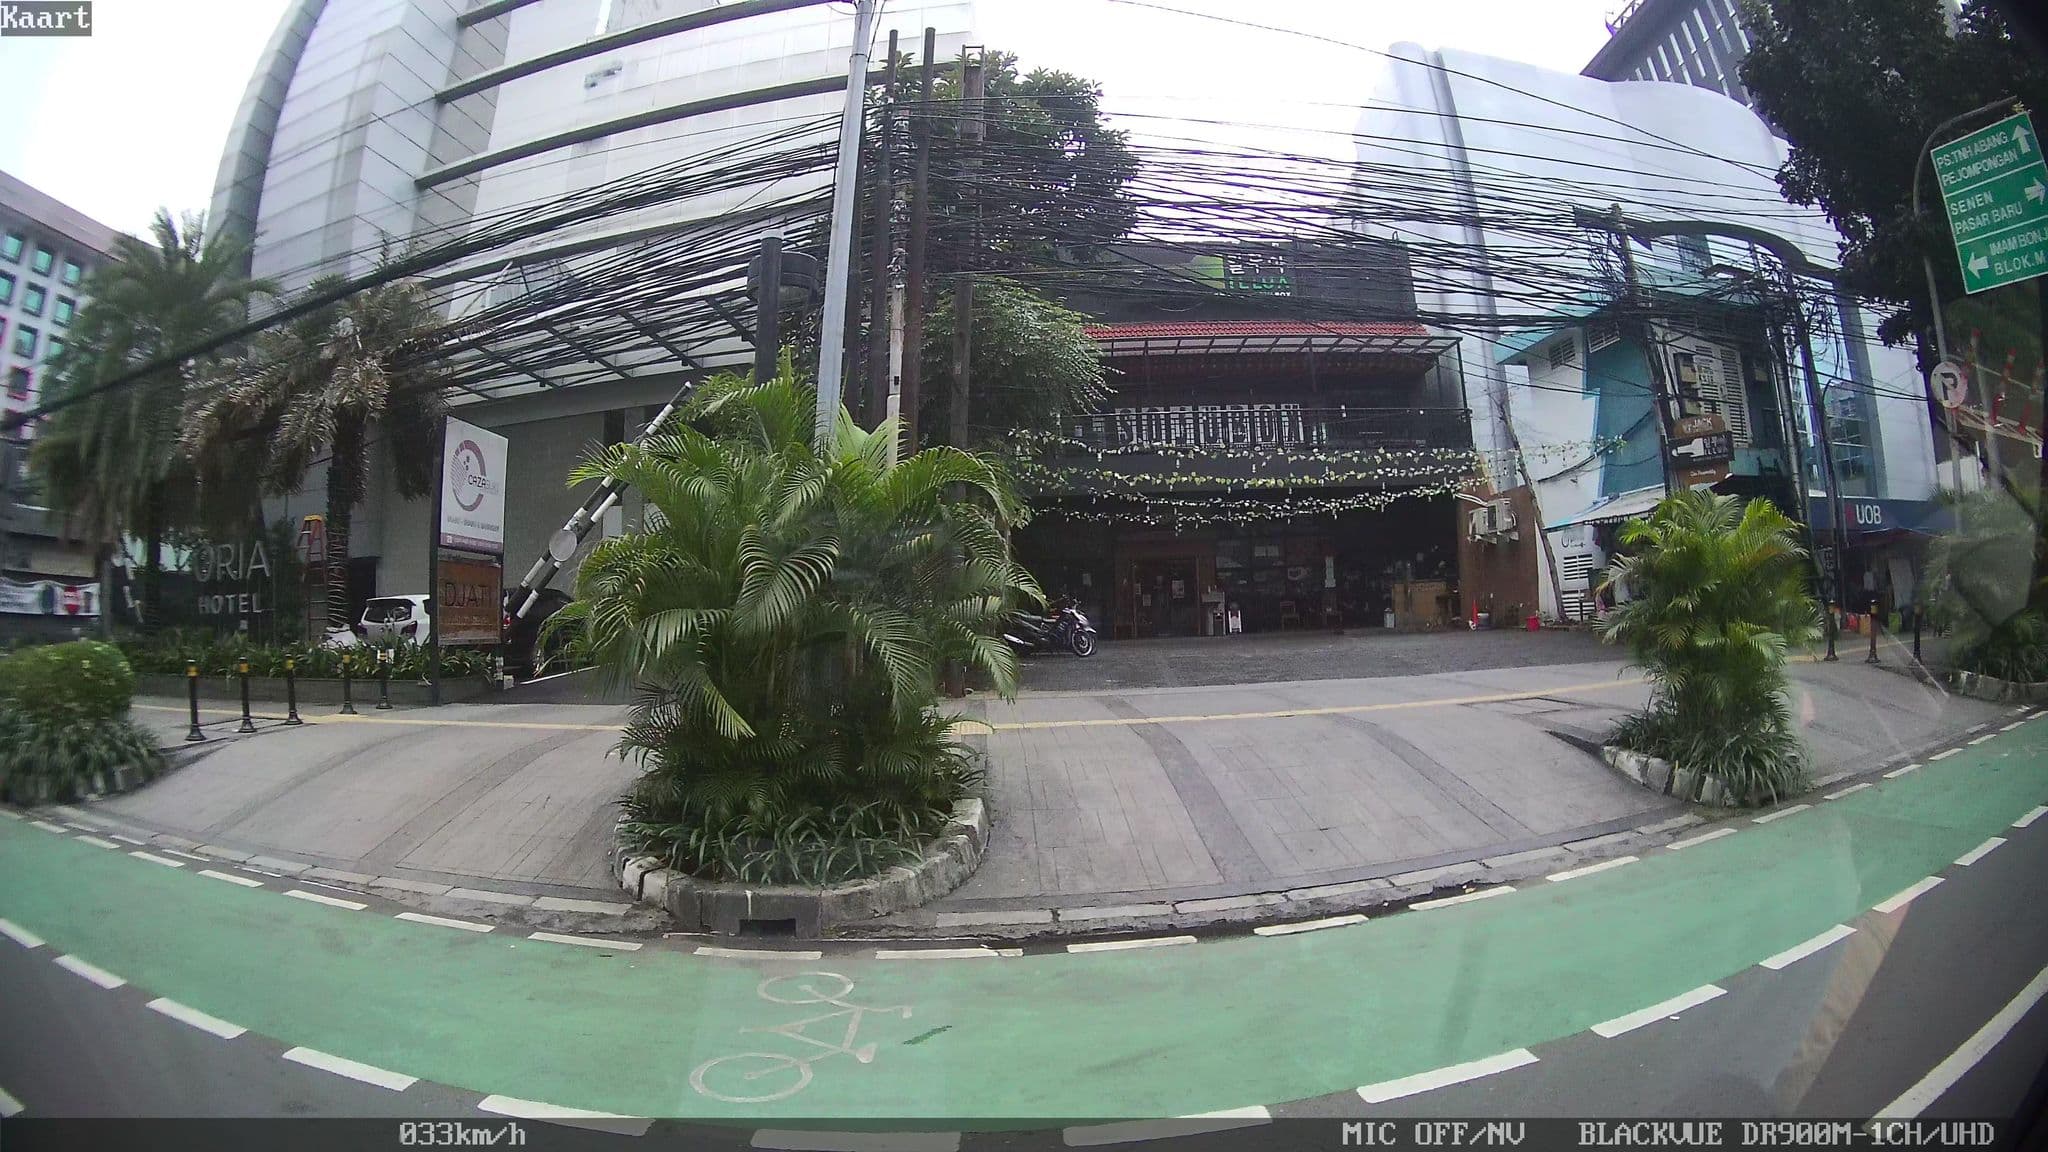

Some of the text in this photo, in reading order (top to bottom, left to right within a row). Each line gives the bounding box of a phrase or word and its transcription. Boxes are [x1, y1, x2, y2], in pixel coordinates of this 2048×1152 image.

[1973, 131, 2008, 155] ABANG
[1941, 149, 2018, 186] PEJOMPONGAN
[1950, 190, 1994, 216] SENEN
[1955, 201, 2023, 235] PASAR BARU
[1989, 236, 2018, 256] IMAM
[1994, 250, 2046, 276] BLOK.M
[1855, 504, 1882, 525] UOB
[199, 592, 263, 615] HOTEL
